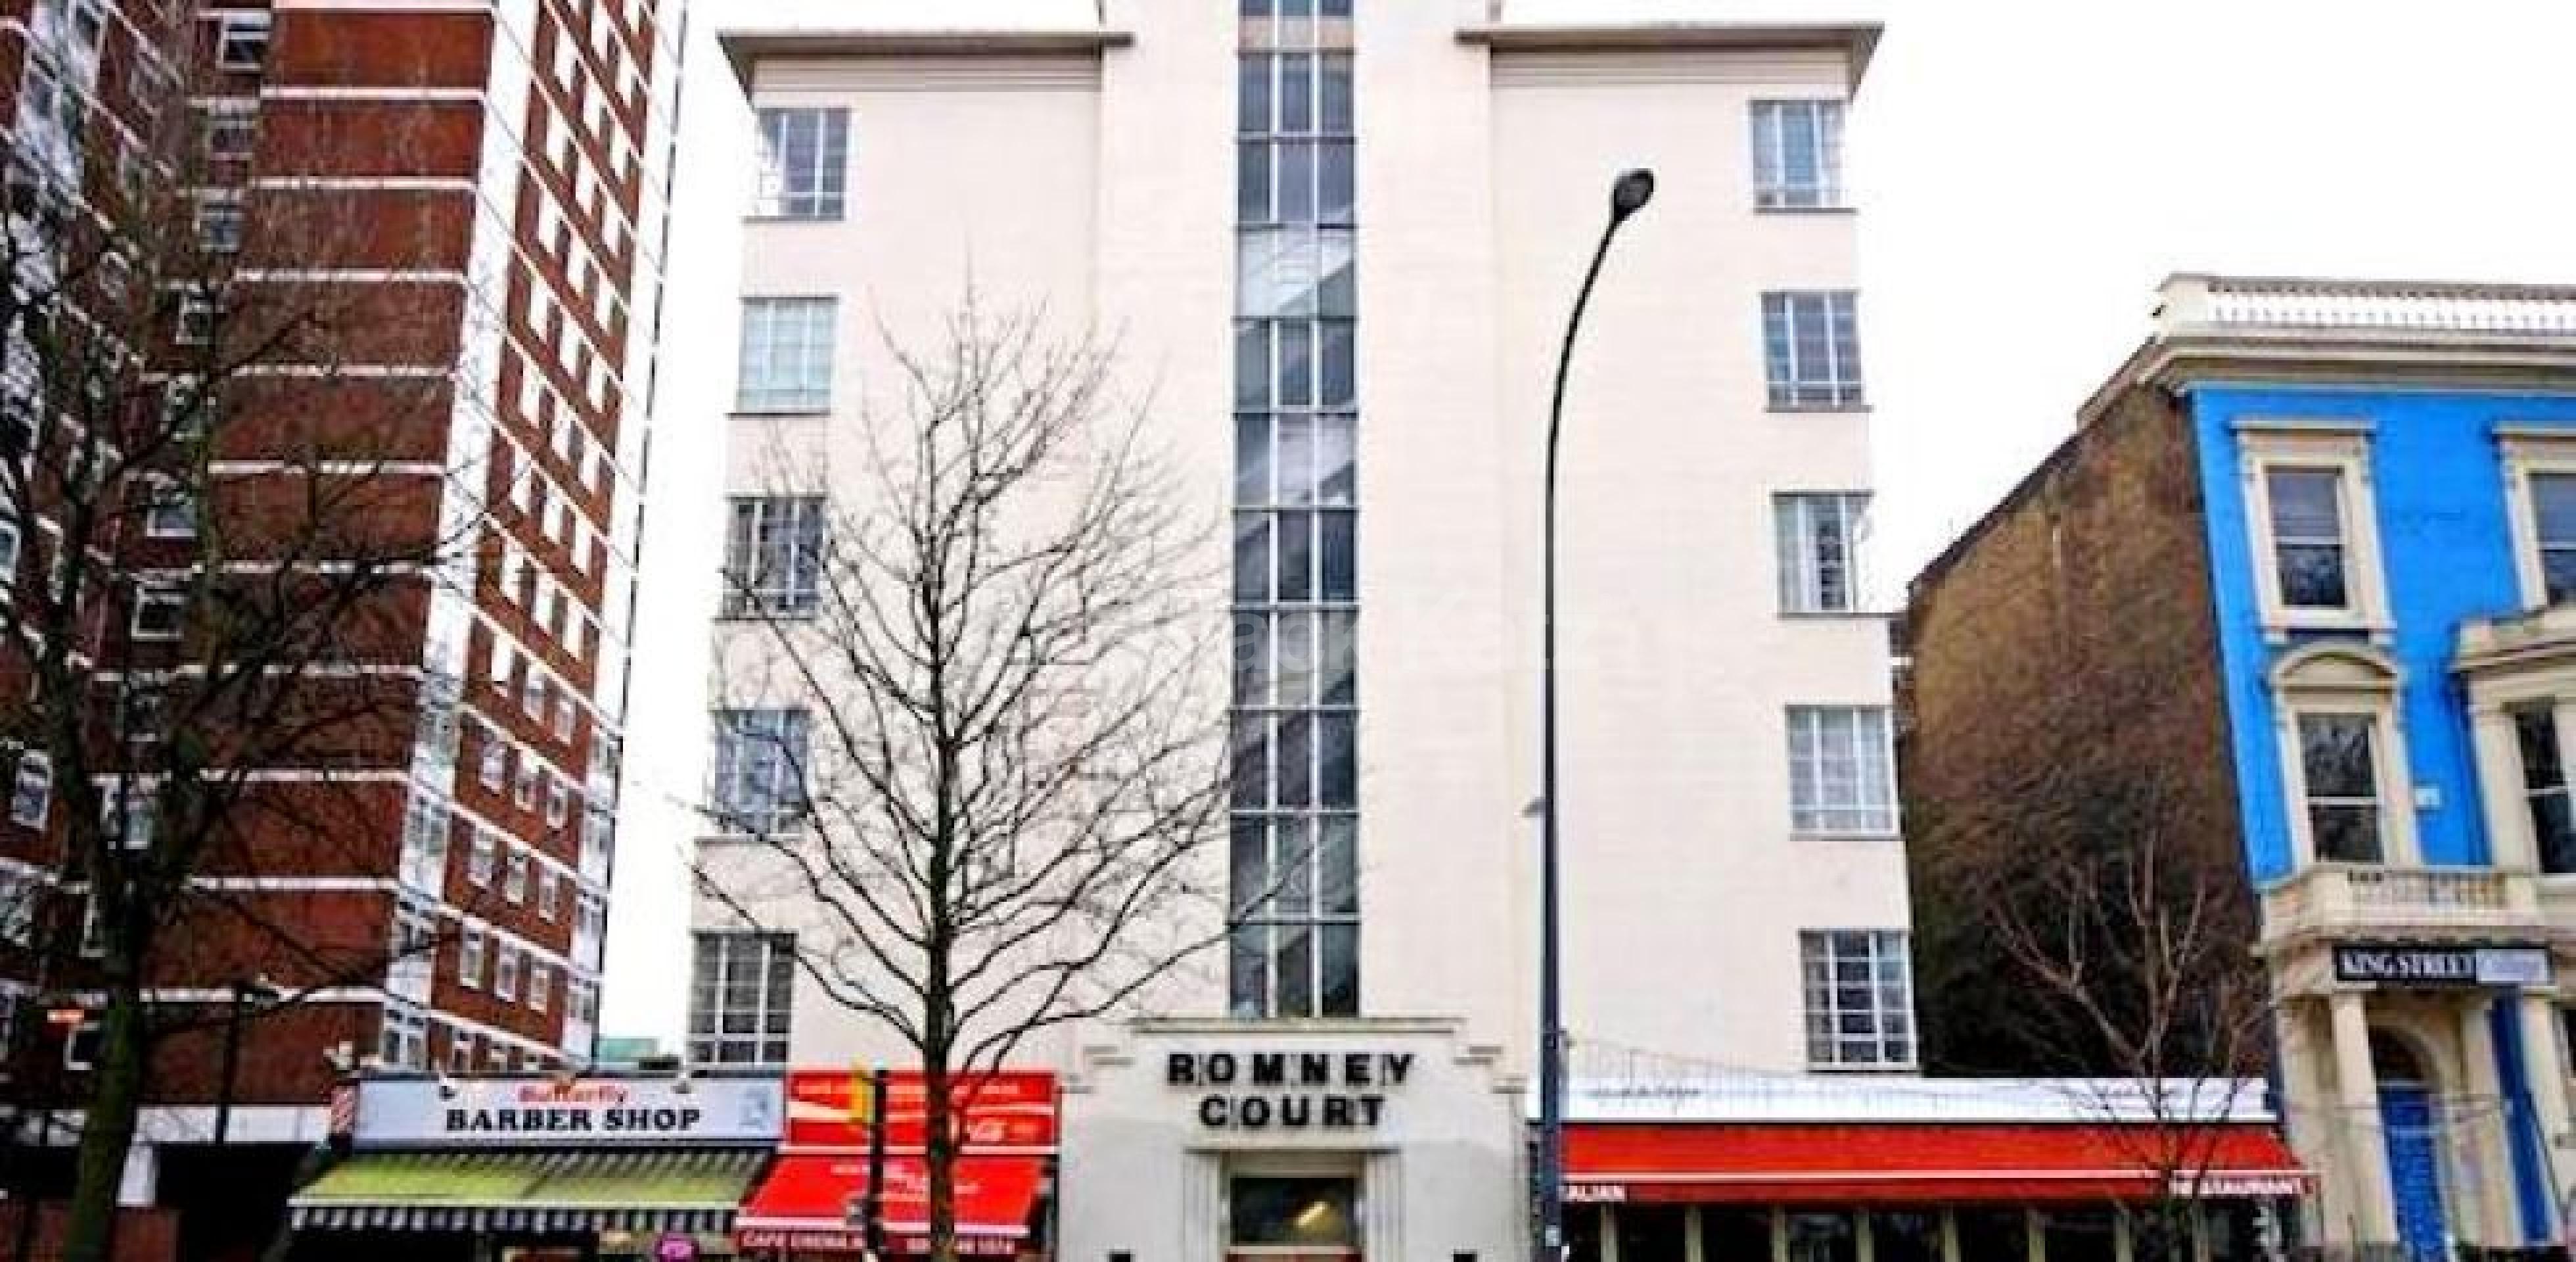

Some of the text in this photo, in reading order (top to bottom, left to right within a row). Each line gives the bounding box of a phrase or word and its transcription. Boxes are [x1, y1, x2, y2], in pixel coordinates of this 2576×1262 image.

[1166, 1052, 1415, 1086] ROMNEY
[445, 1108, 701, 1132] BARBER SHOP
[1198, 1095, 1386, 1128] COURT
